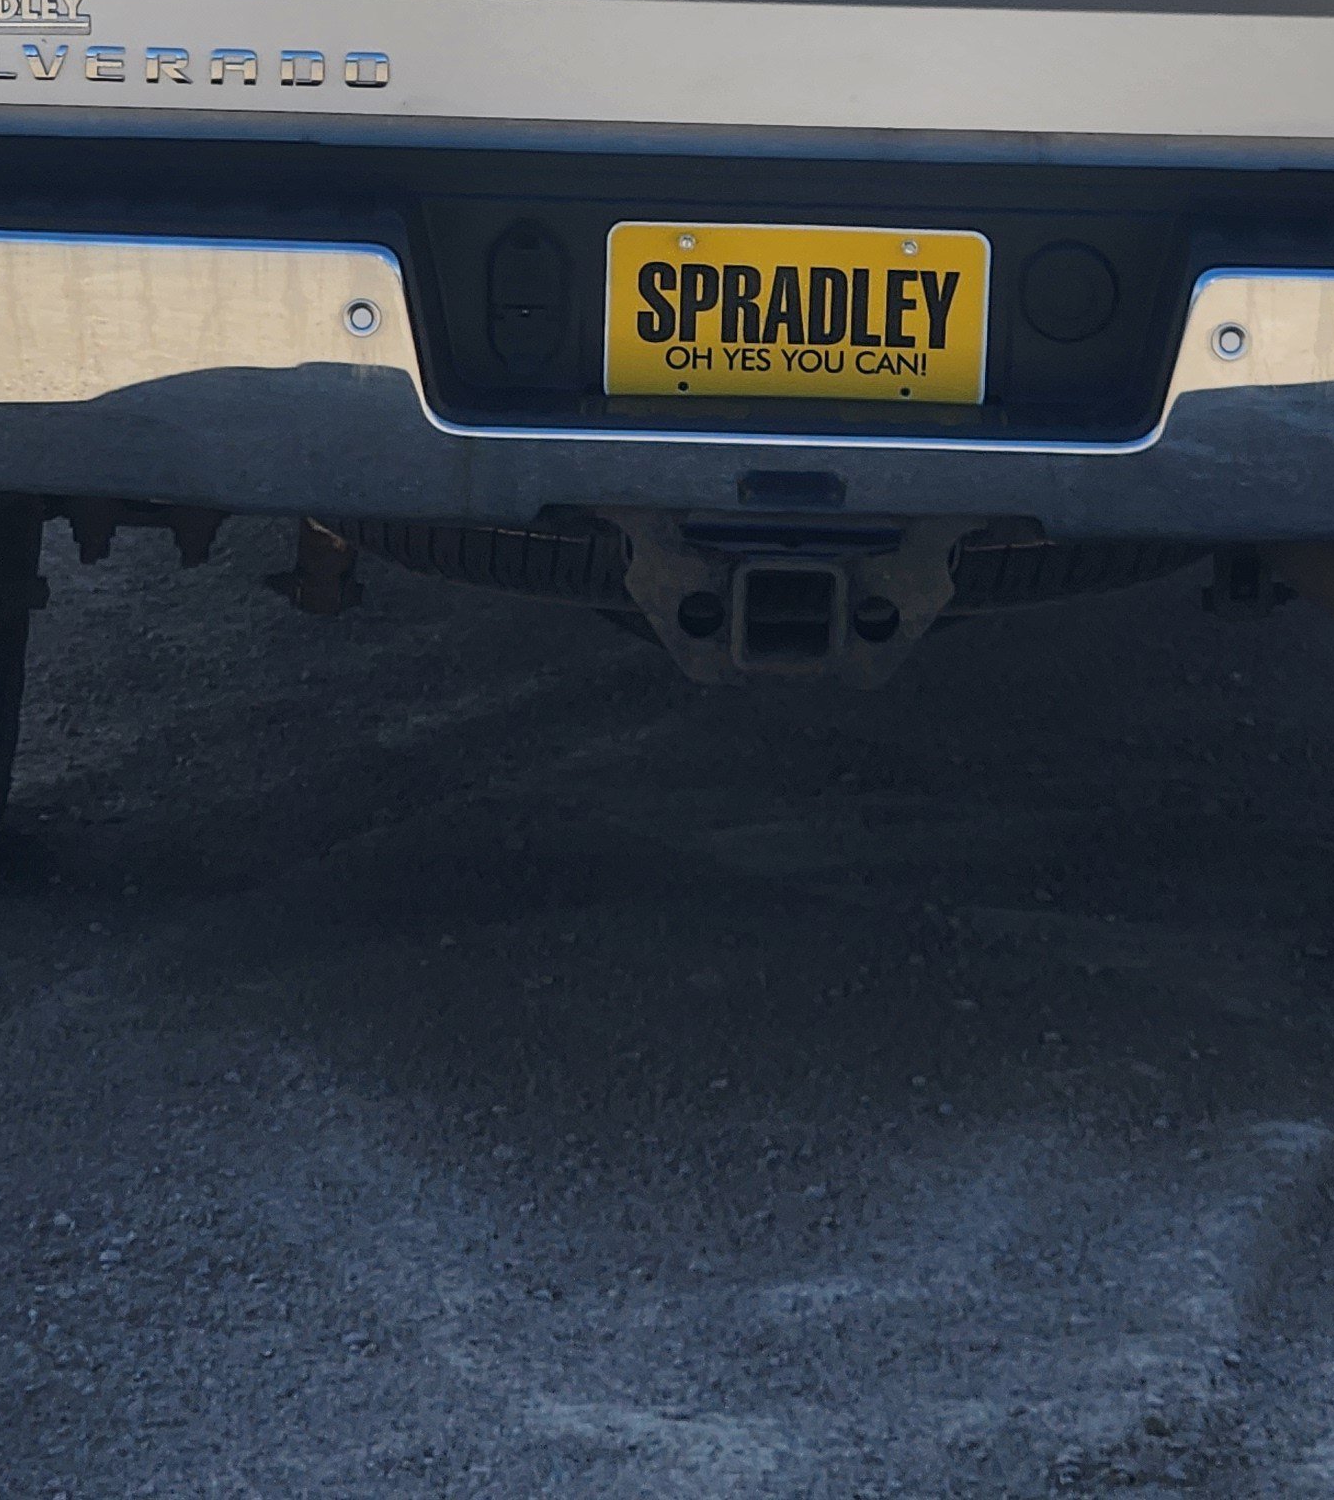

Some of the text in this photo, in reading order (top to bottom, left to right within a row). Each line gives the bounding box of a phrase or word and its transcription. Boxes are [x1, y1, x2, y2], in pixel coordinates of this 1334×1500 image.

[636, 262, 961, 350] SPRADLEY
[665, 345, 928, 377] OH YES YOU CAN!
